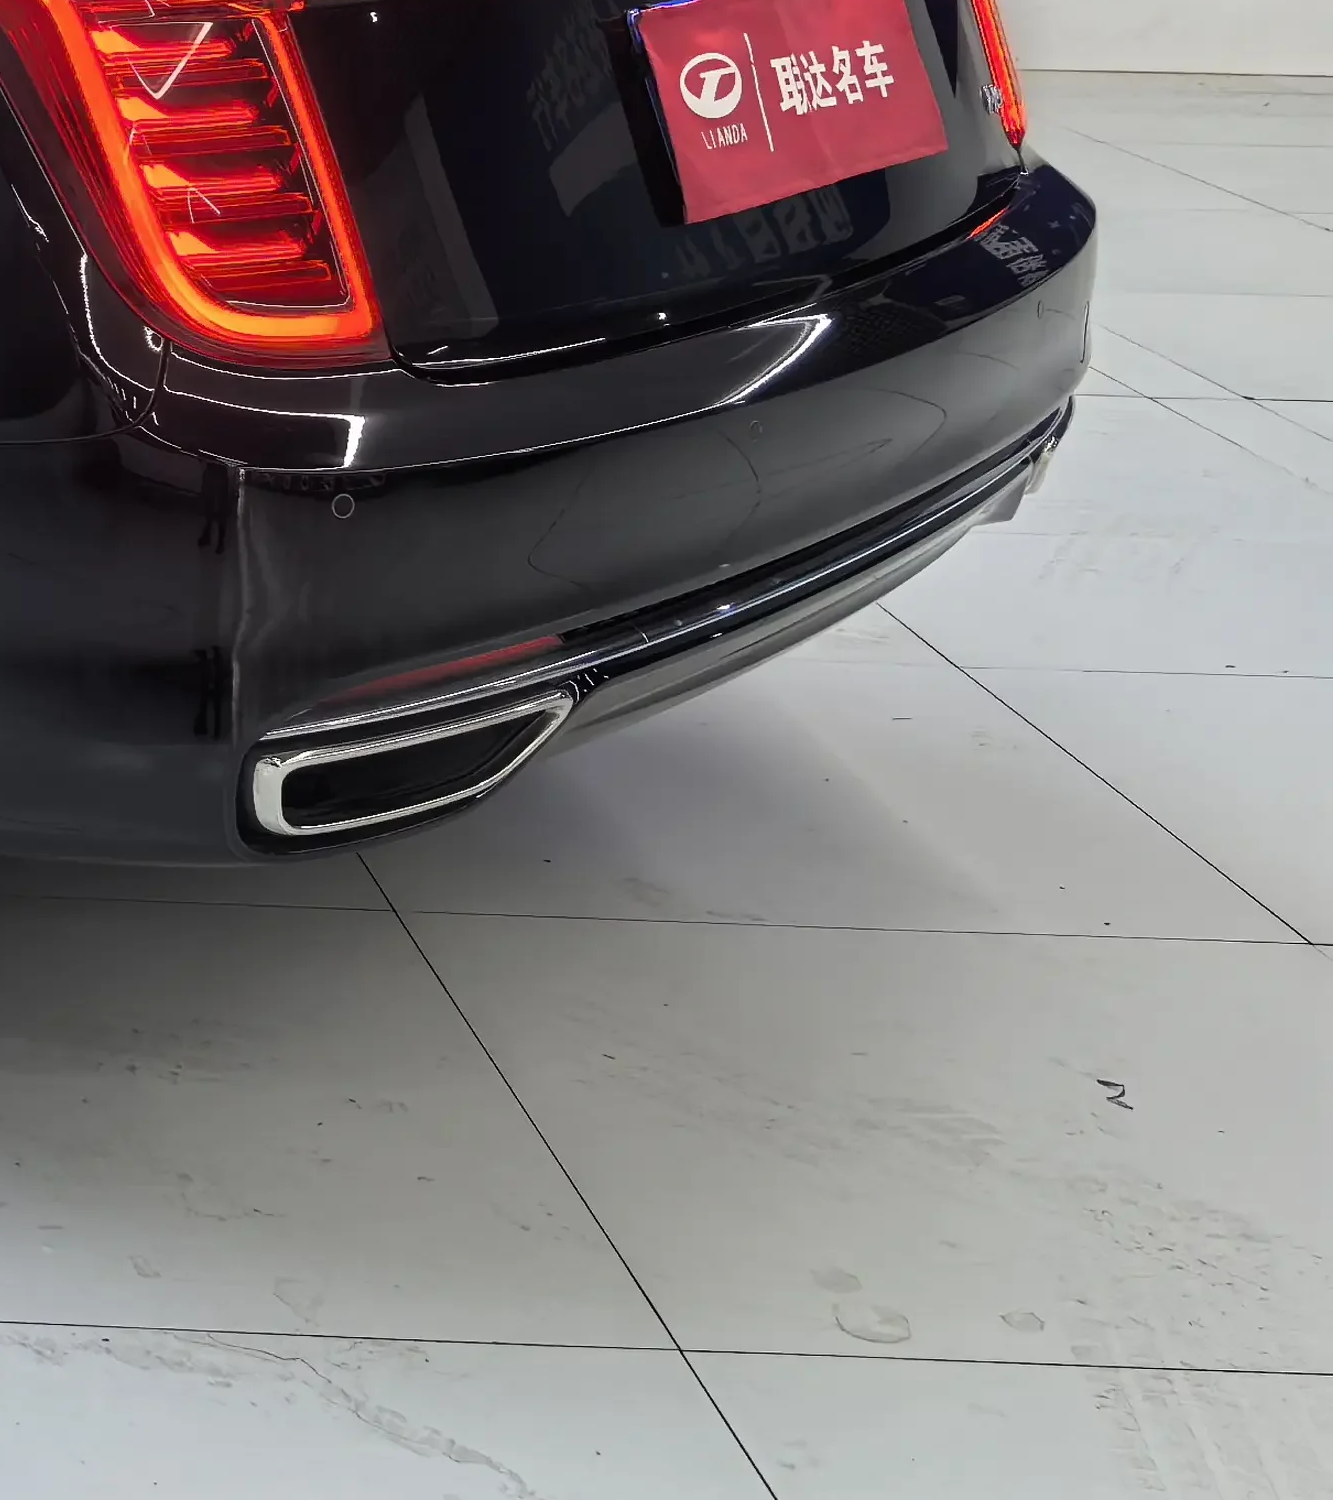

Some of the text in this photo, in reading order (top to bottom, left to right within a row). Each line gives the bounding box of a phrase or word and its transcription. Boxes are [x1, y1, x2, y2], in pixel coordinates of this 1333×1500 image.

[770, 40, 895, 115] 联达名车
[700, 122, 748, 150] LIANDA
